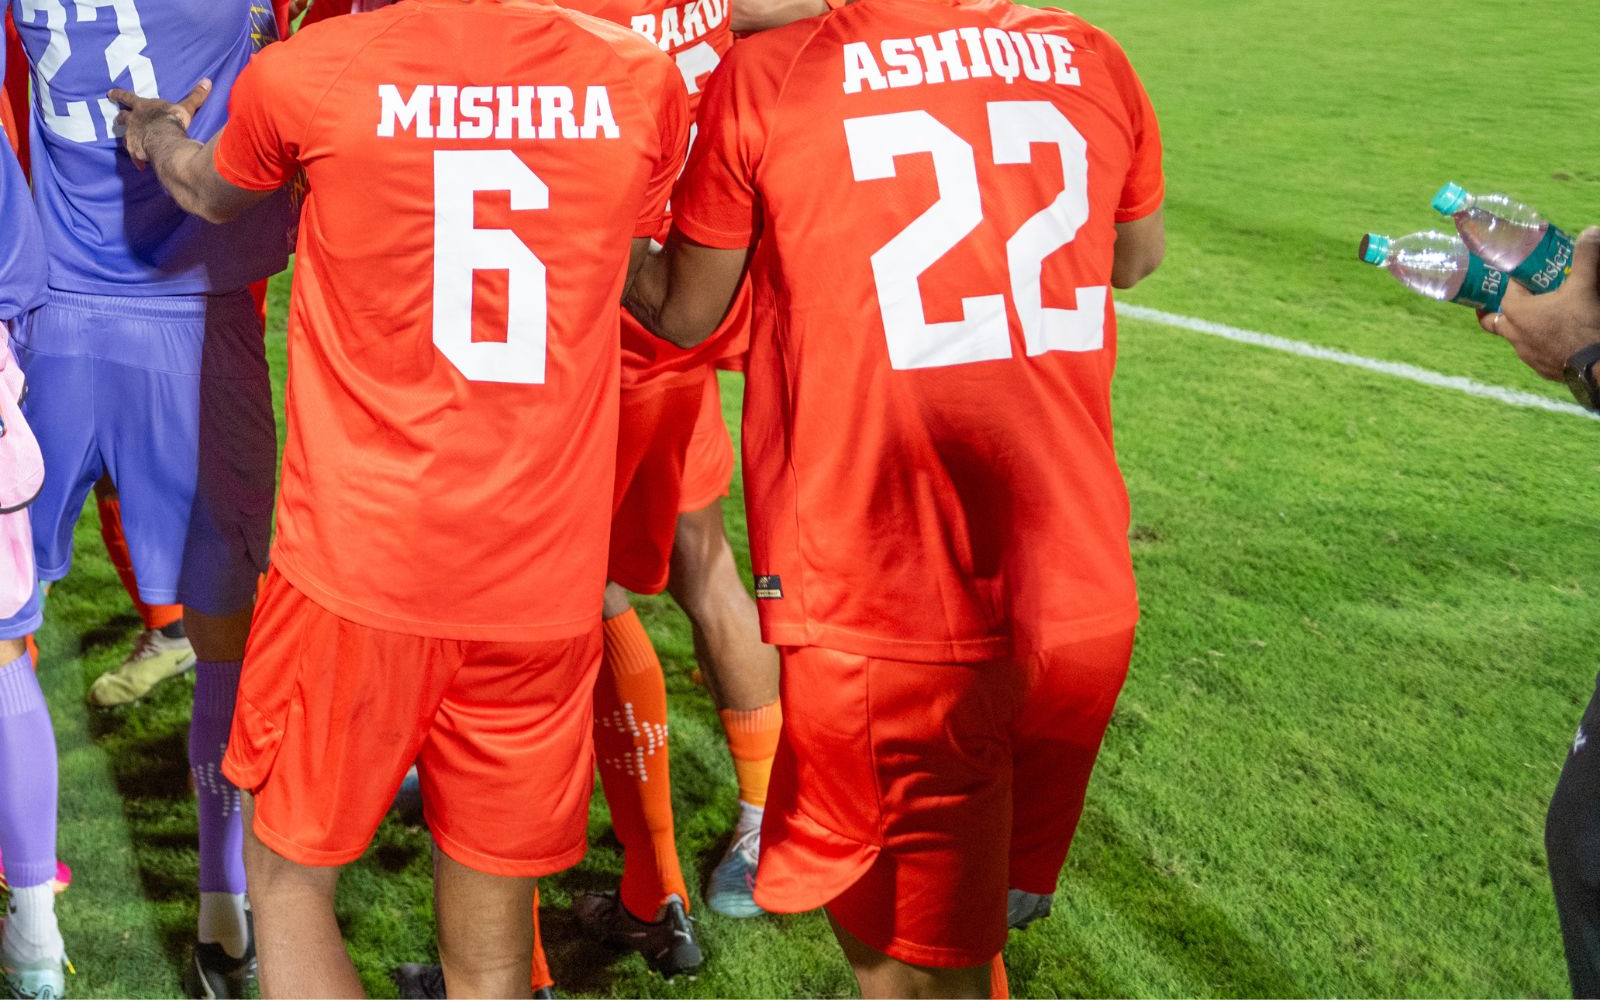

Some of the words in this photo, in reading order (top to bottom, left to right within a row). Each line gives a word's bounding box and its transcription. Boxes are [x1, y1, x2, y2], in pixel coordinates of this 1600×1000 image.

[842, 26, 1081, 94] ASHIQUE
[376, 84, 620, 139] MISHRA
[843, 100, 1107, 370] 22
[1531, 241, 1572, 289] Bisleri
[432, 149, 549, 384] 6
[1481, 263, 1502, 296] Bisl
